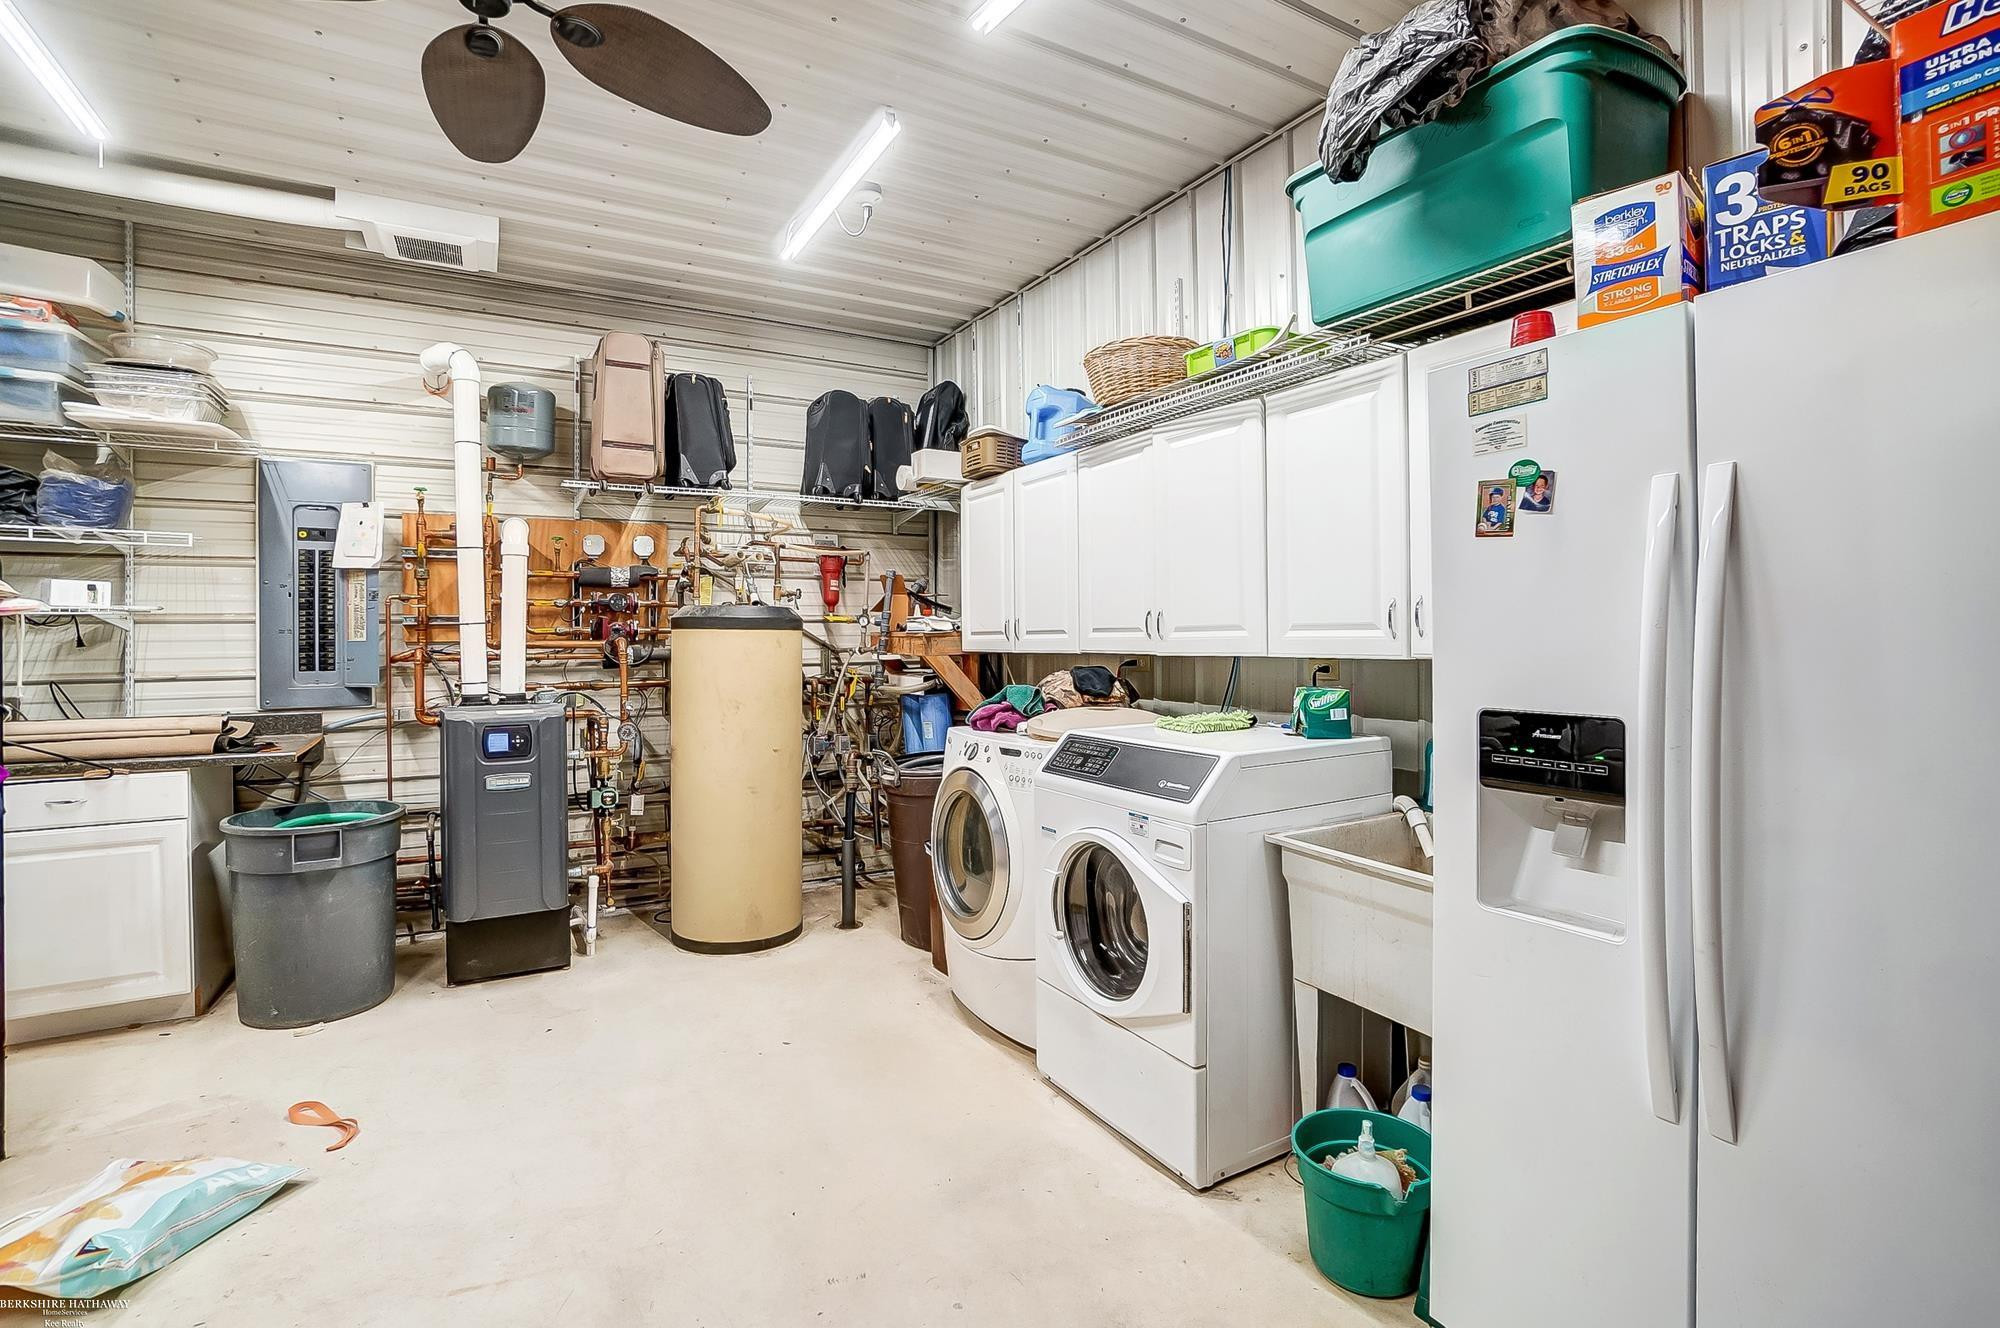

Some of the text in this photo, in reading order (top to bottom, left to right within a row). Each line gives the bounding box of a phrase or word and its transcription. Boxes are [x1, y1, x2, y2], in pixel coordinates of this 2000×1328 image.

[1925, 37, 1991, 69] ULTRA
[1952, 73, 1982, 88] Trash
[1769, 137, 1829, 160] PROTECTION
[1852, 163, 1890, 183] 90
[1655, 181, 1672, 193] 90
[1715, 171, 1758, 226] 3
[1844, 181, 1891, 196] BAGS
[1605, 206, 1648, 225] berkley
[1714, 209, 1807, 247] TRAPS
[1720, 230, 1806, 262] LOCKS &
[1720, 244, 1806, 272] NEUTRALIZES
[1592, 255, 1662, 285] STRETCHFLEX
[1603, 282, 1652, 301] STRONG
